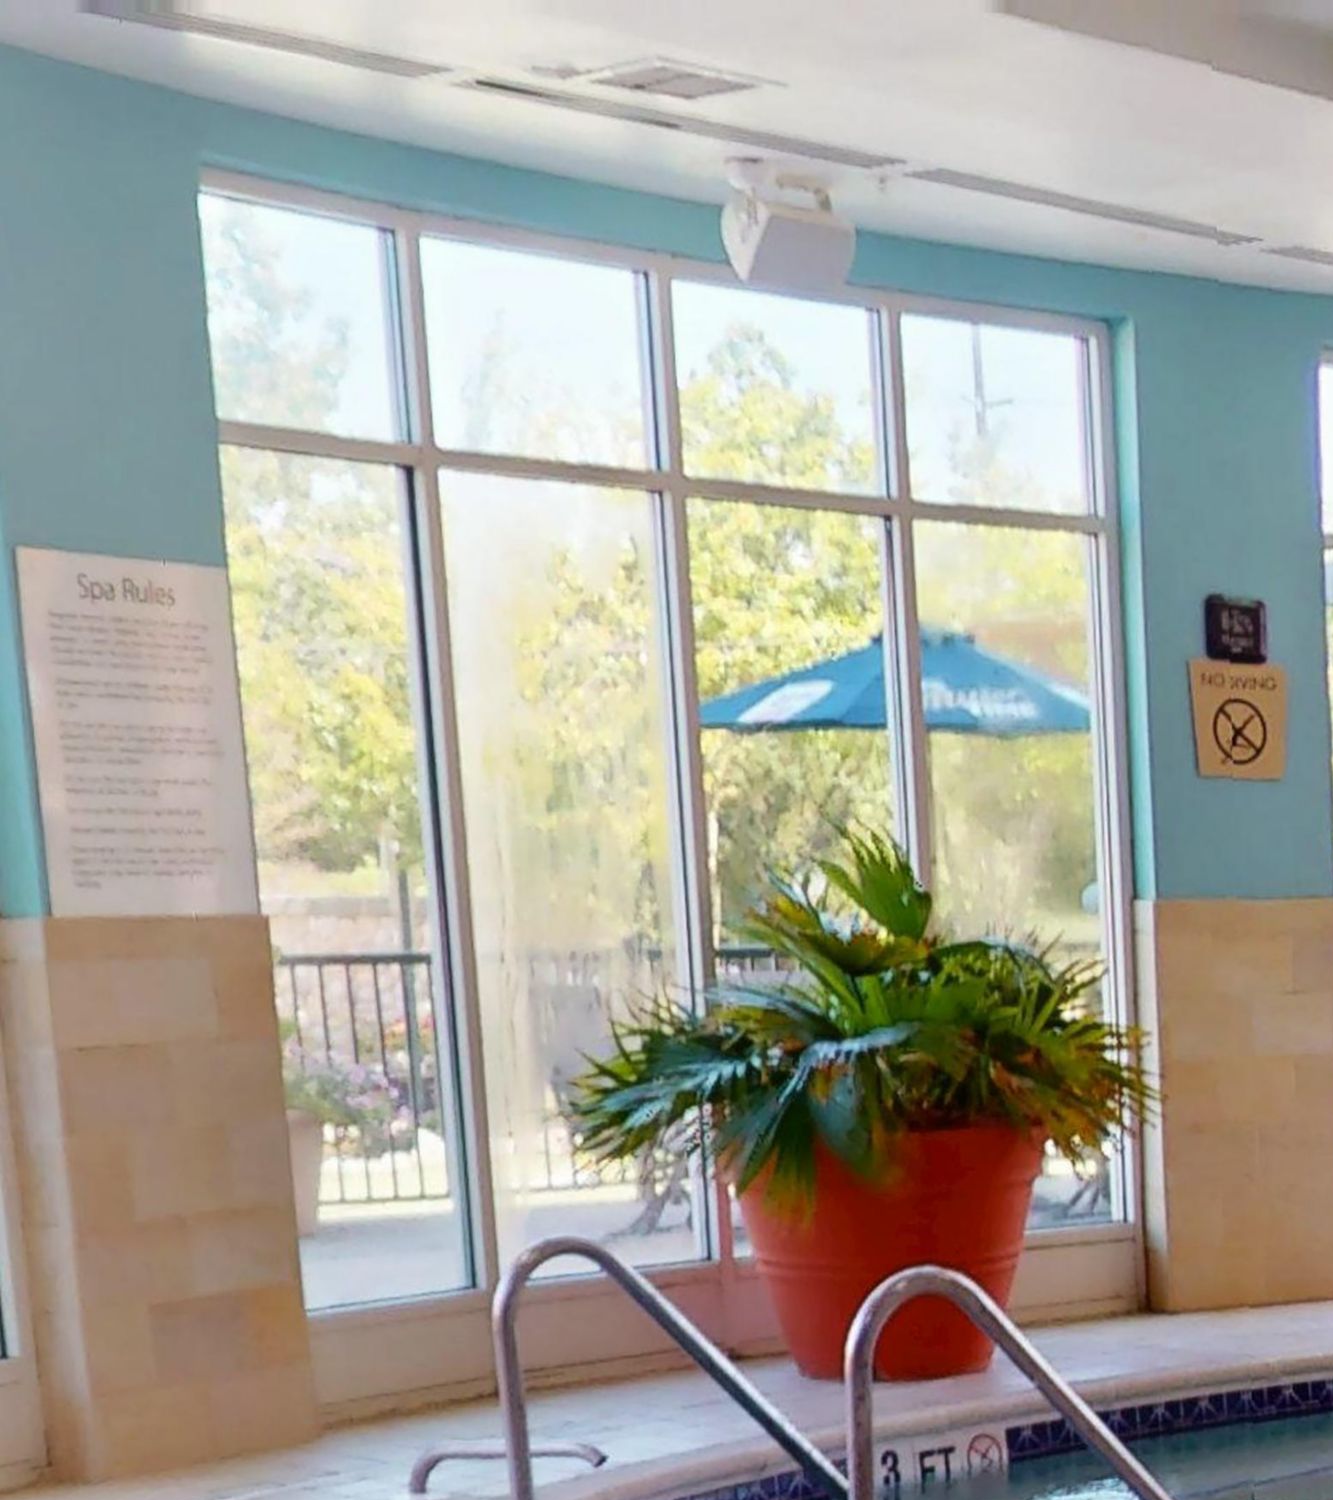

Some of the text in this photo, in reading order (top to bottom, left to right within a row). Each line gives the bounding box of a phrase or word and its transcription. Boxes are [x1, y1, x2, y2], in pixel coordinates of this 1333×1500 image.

[76, 573, 176, 607] Spa Rules
[1200, 672, 1226, 688] NO
[880, 1446, 956, 1485] 3 FT
